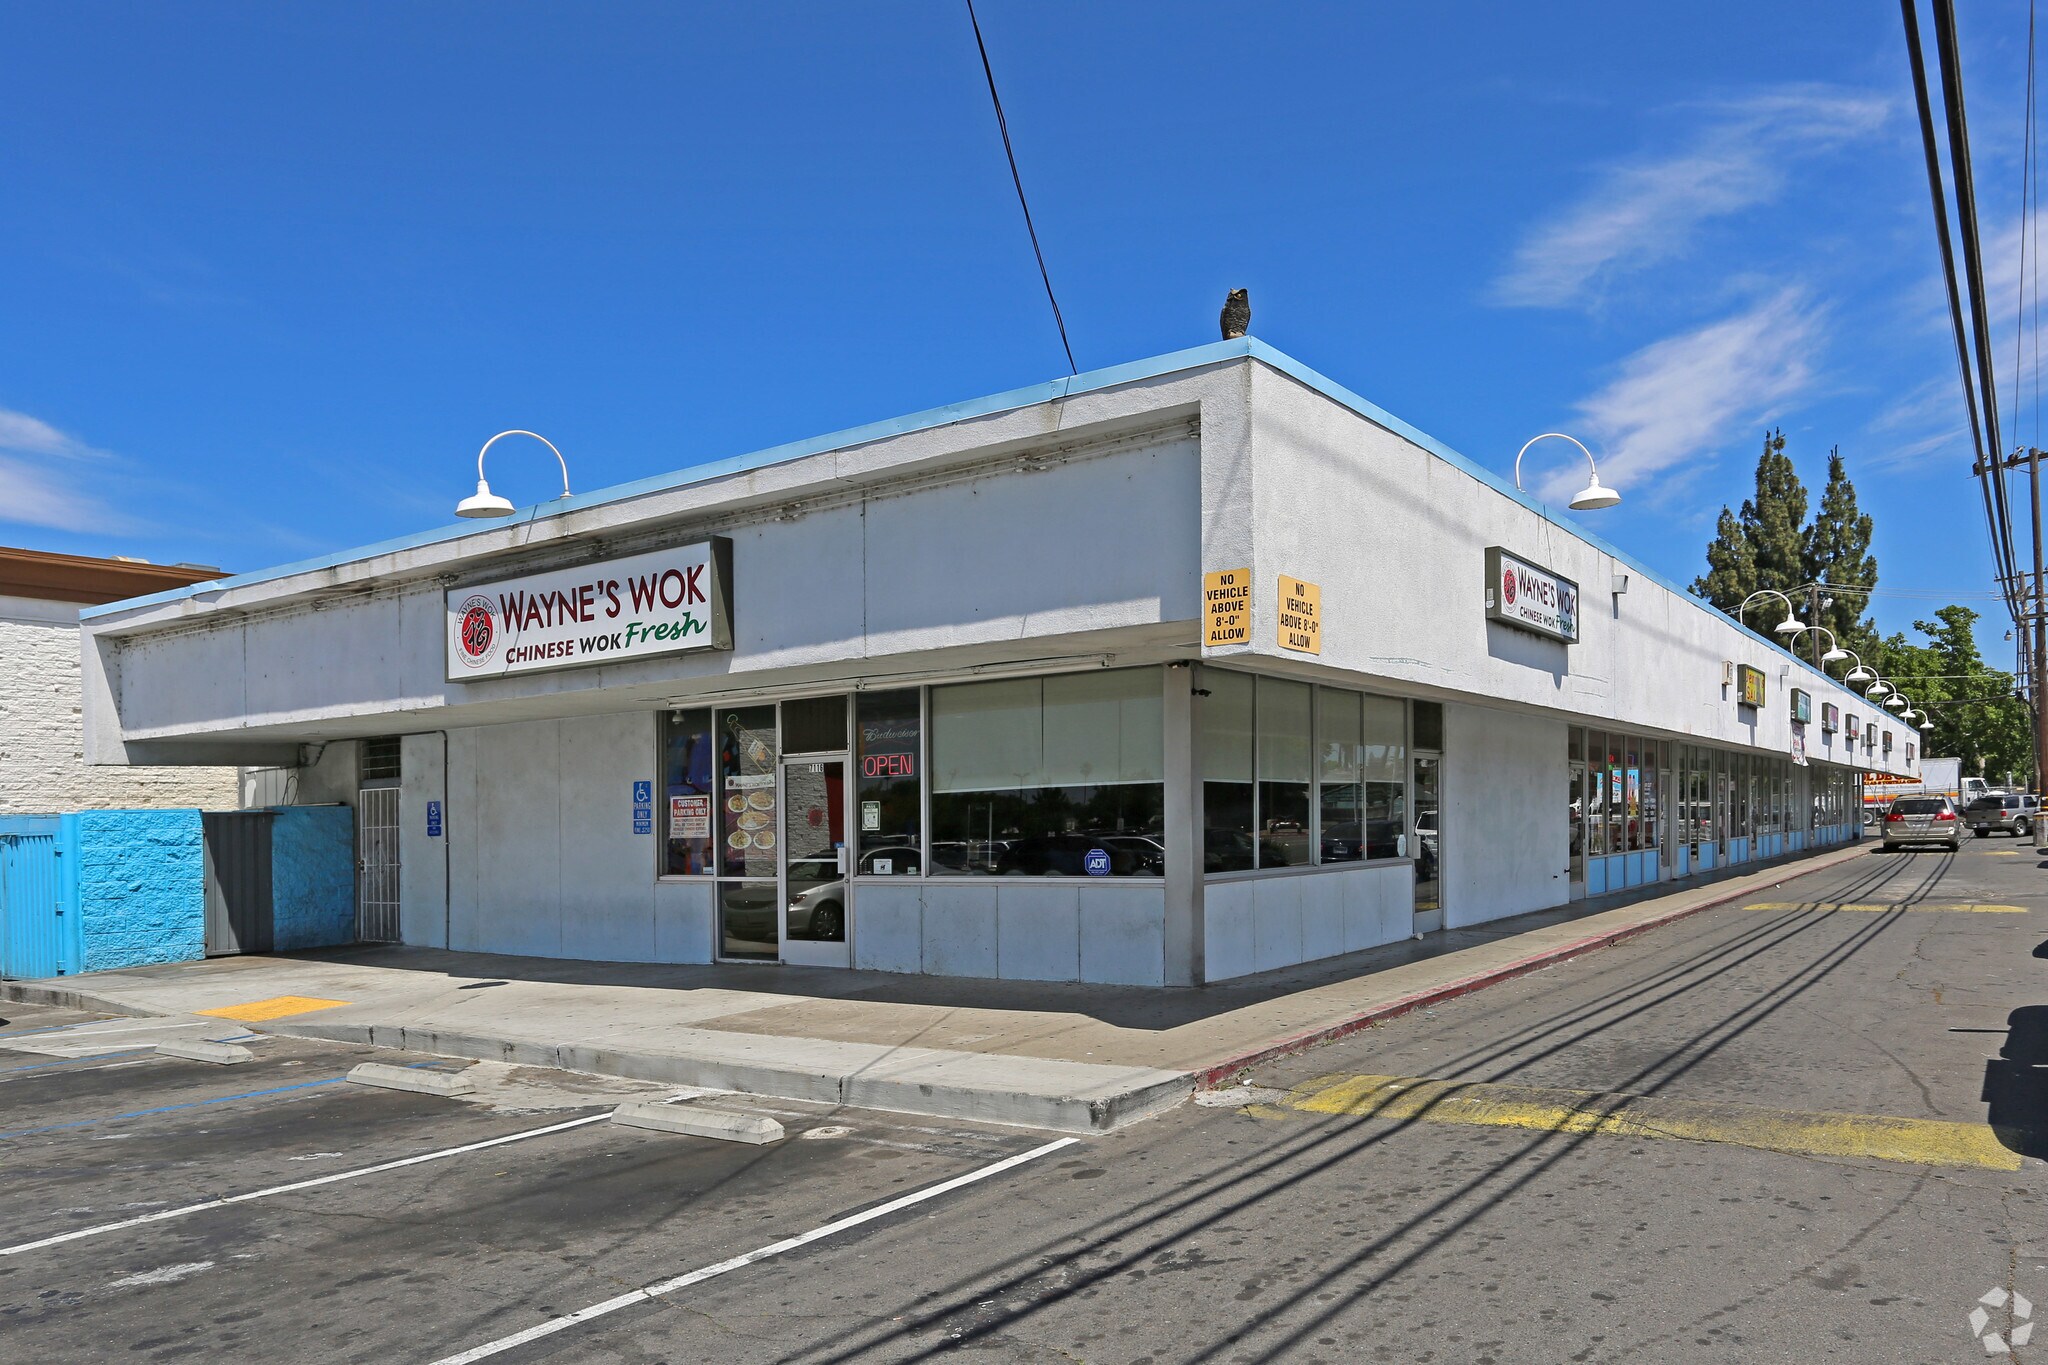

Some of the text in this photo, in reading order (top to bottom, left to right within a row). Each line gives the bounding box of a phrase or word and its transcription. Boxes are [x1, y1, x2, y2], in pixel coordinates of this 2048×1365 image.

[1220, 574, 1234, 585] NO
[1207, 586, 1248, 601] VEHICLE
[1295, 583, 1305, 597] NO
[1518, 566, 1555, 608] WAYNE'S
[1556, 588, 1575, 616] WOK
[500, 564, 706, 634] WAYNE'S WOK
[1211, 600, 1244, 614] ABOVE
[1286, 597, 1313, 616] VEHICLE
[483, 600, 496, 618] WOK
[1520, 606, 1542, 623] CHINESE
[1543, 614, 1556, 629] WOK
[1280, 613, 1302, 630] ABOVE
[506, 611, 707, 664] CHINESE WOK Fresh
[1211, 628, 1245, 641] ALLOW
[1289, 633, 1311, 648] ALLOW
[467, 656, 485, 665] CHINESE
[485, 643, 496, 659] FOOD
[863, 728, 919, 741] Budweiser
[864, 754, 912, 776] OPEN
[1089, 858, 1106, 869] ADT
